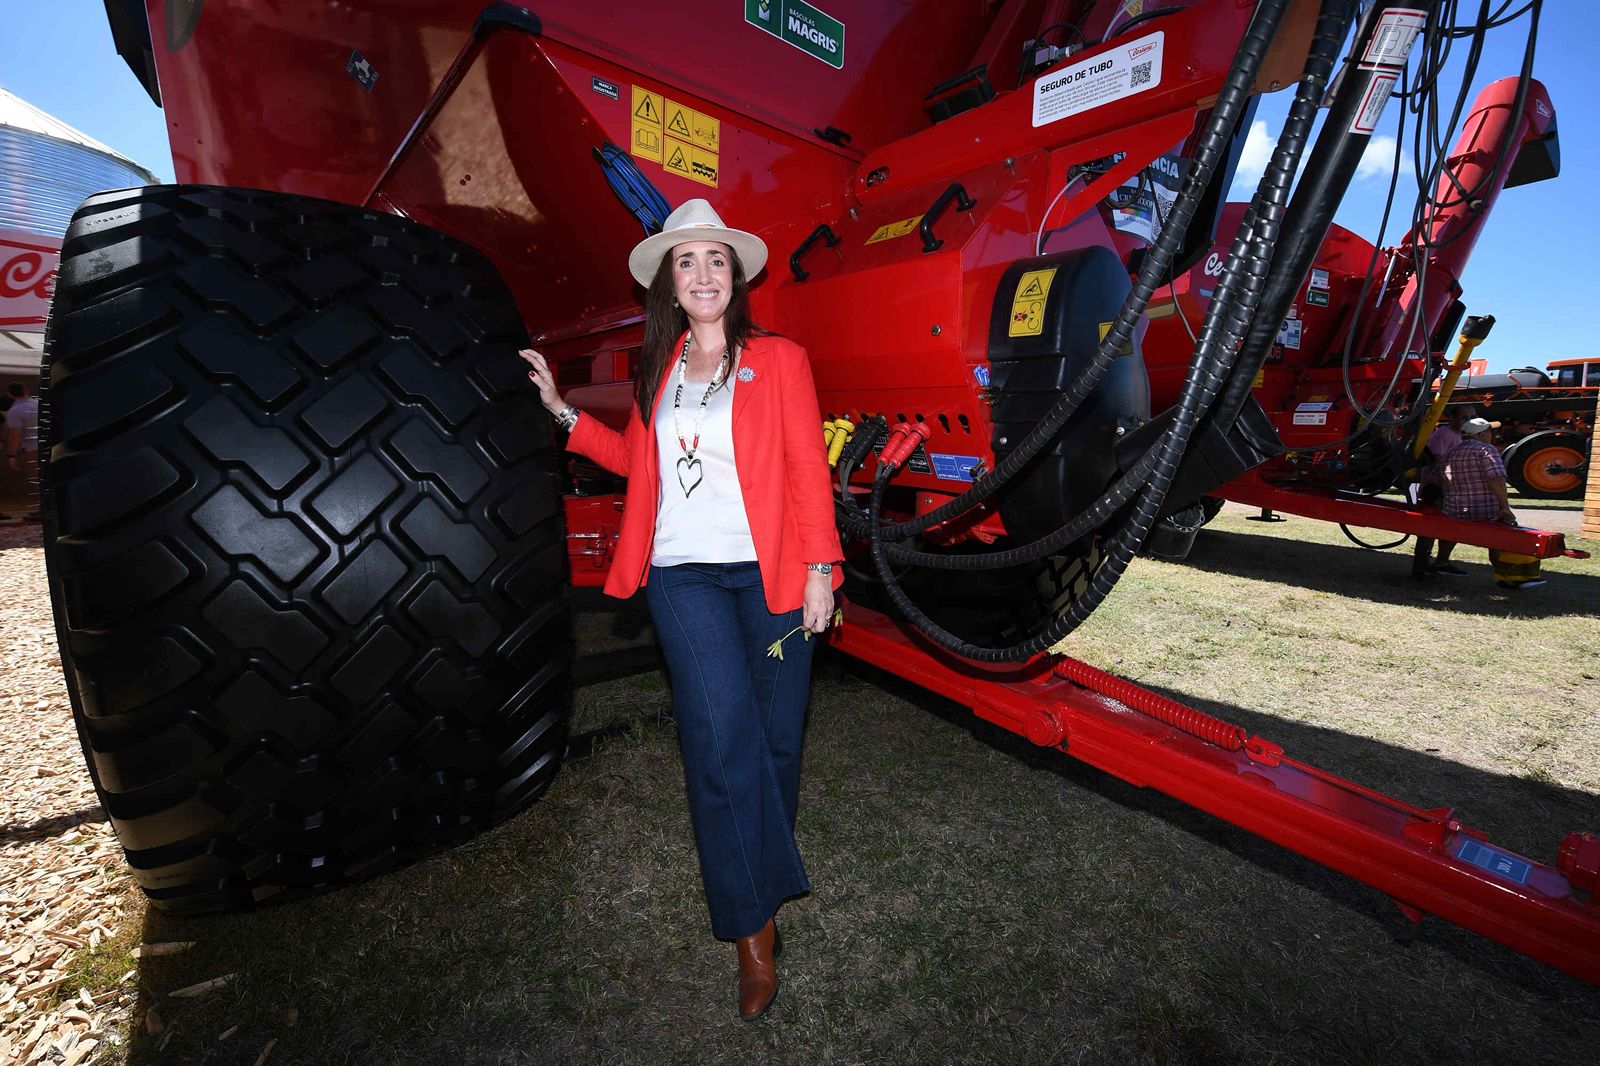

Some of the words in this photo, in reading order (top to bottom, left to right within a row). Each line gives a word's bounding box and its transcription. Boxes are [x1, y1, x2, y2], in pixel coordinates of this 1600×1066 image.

[788, 16, 837, 53] MAGRIS
[1040, 75, 1073, 94] SEGURO
[1075, 69, 1087, 81] DE
[1089, 60, 1113, 76] TUBO
